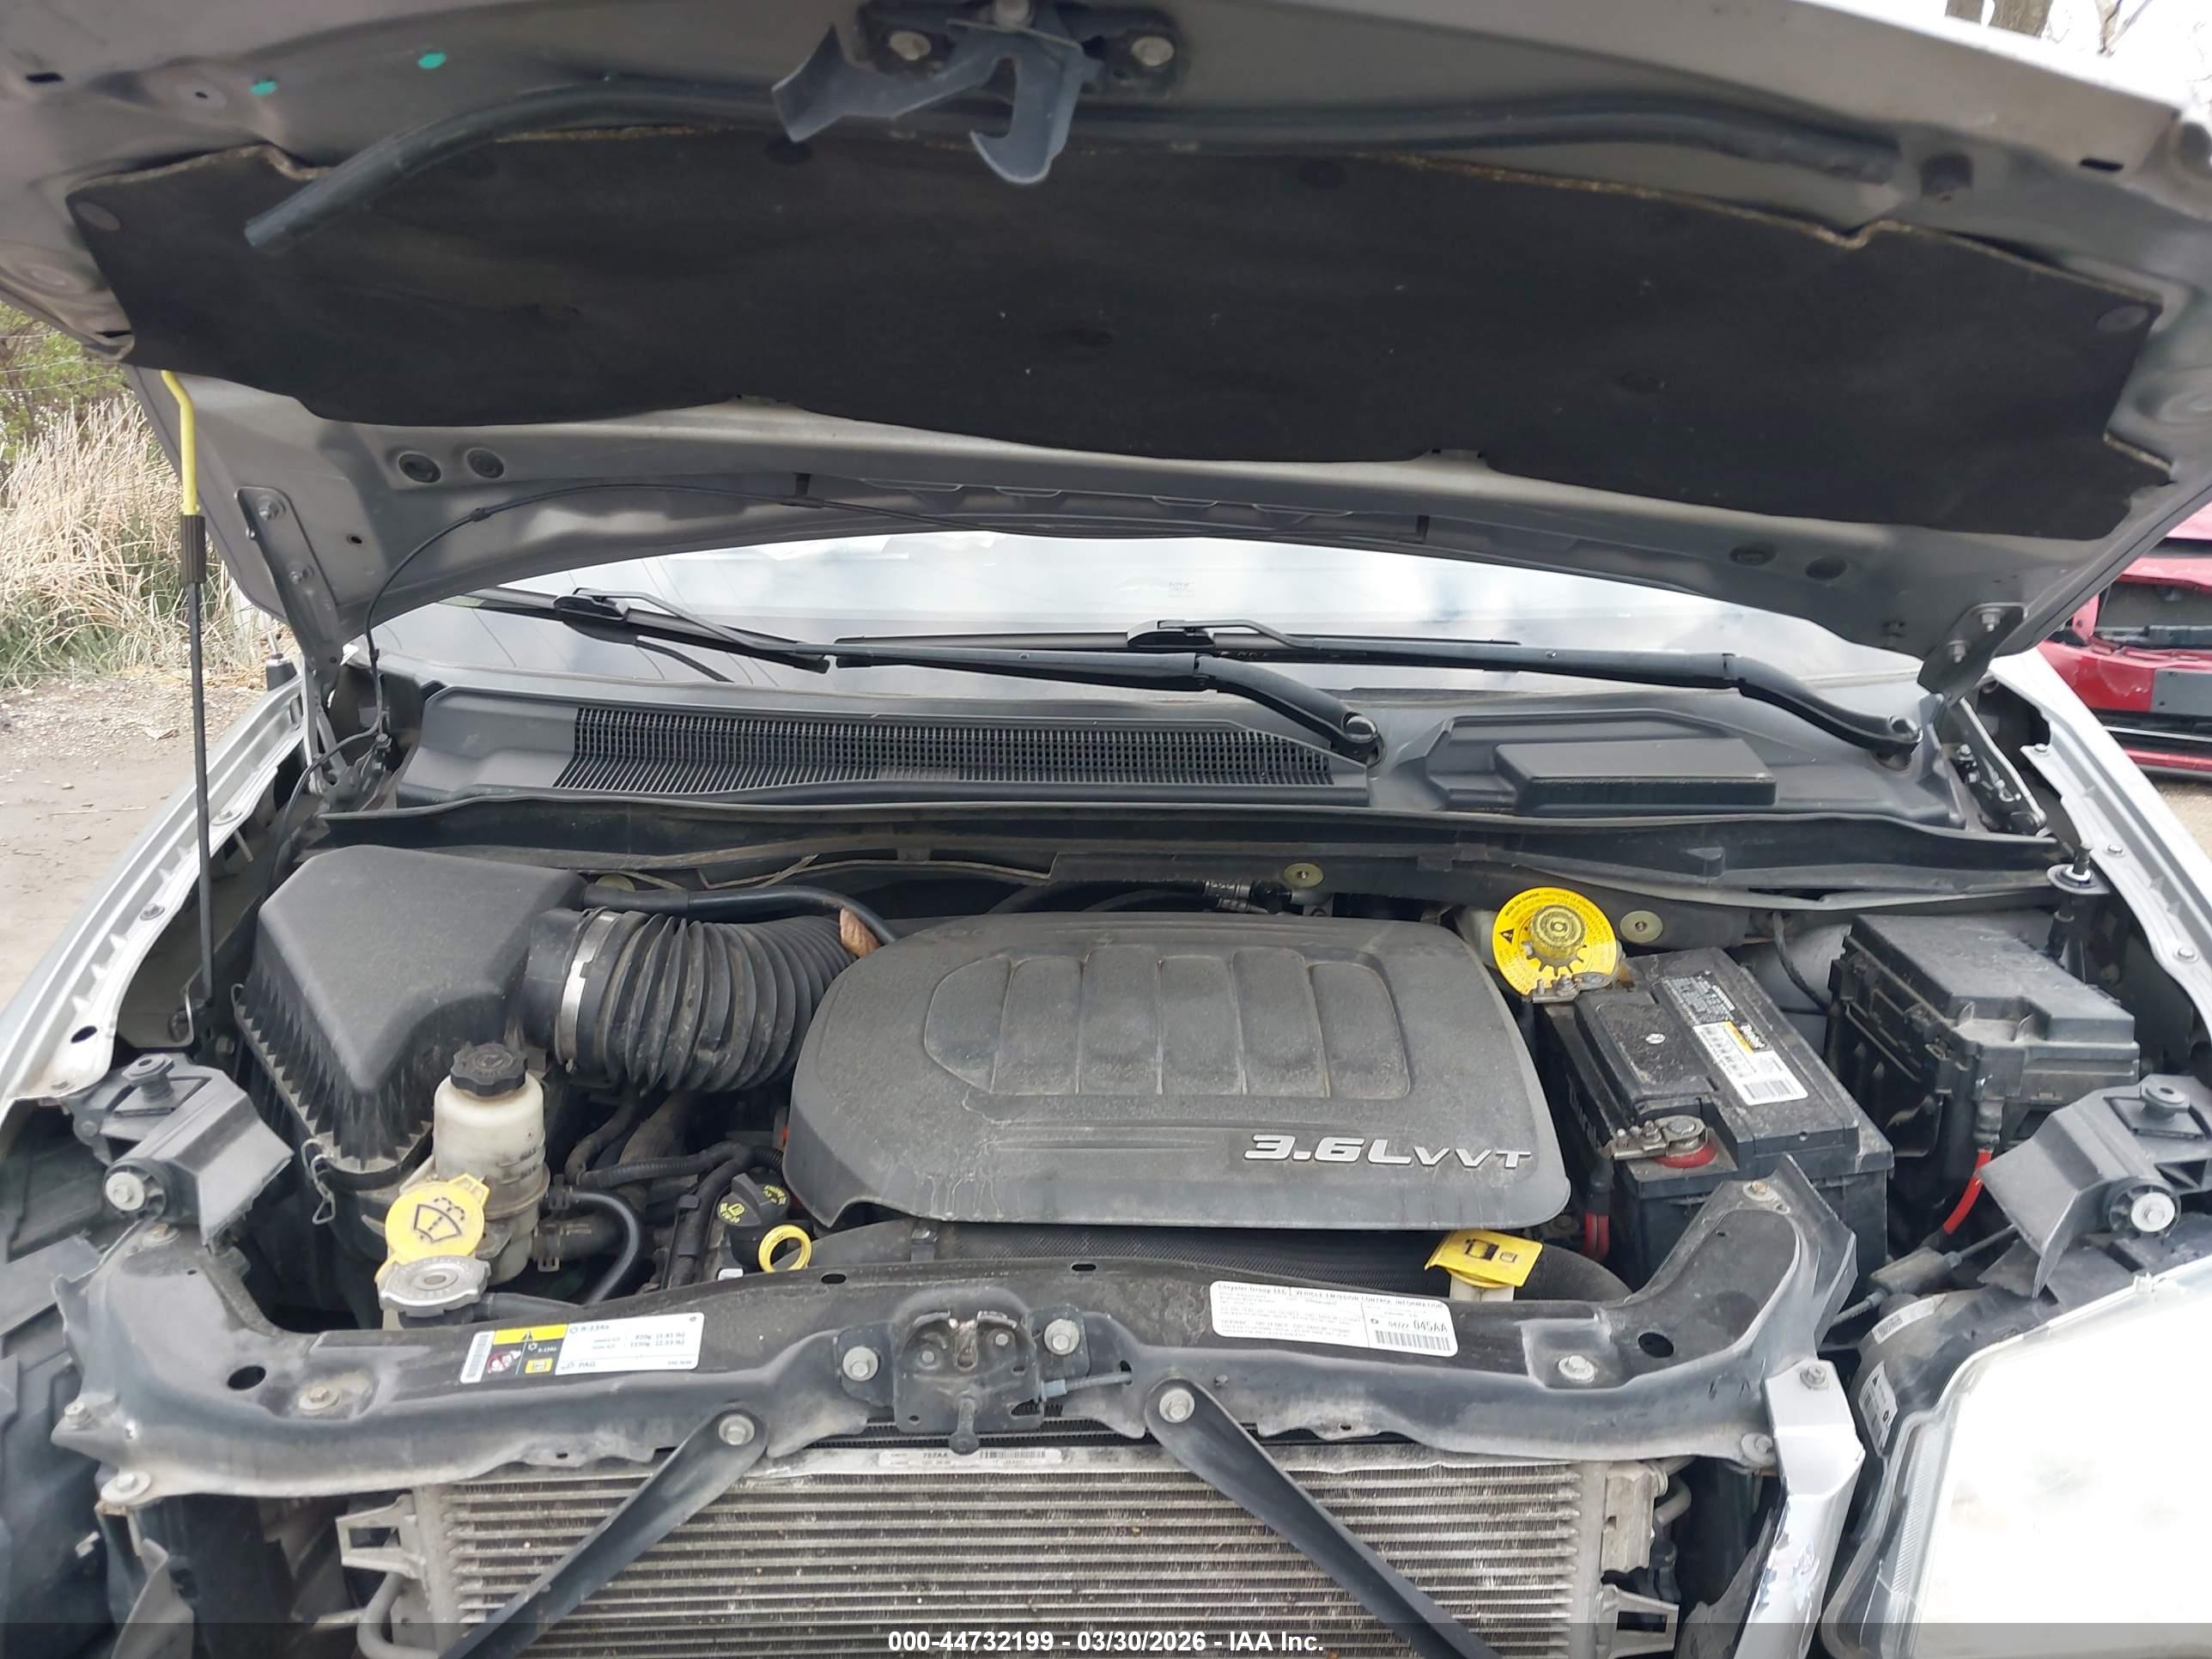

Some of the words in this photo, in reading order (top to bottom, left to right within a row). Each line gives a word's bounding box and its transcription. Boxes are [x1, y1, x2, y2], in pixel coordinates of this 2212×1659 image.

[1244, 1133, 1413, 1165] 3.6L
[1414, 1146, 1531, 1169] VVT
[1218, 1284, 1248, 1292] Chrysler
